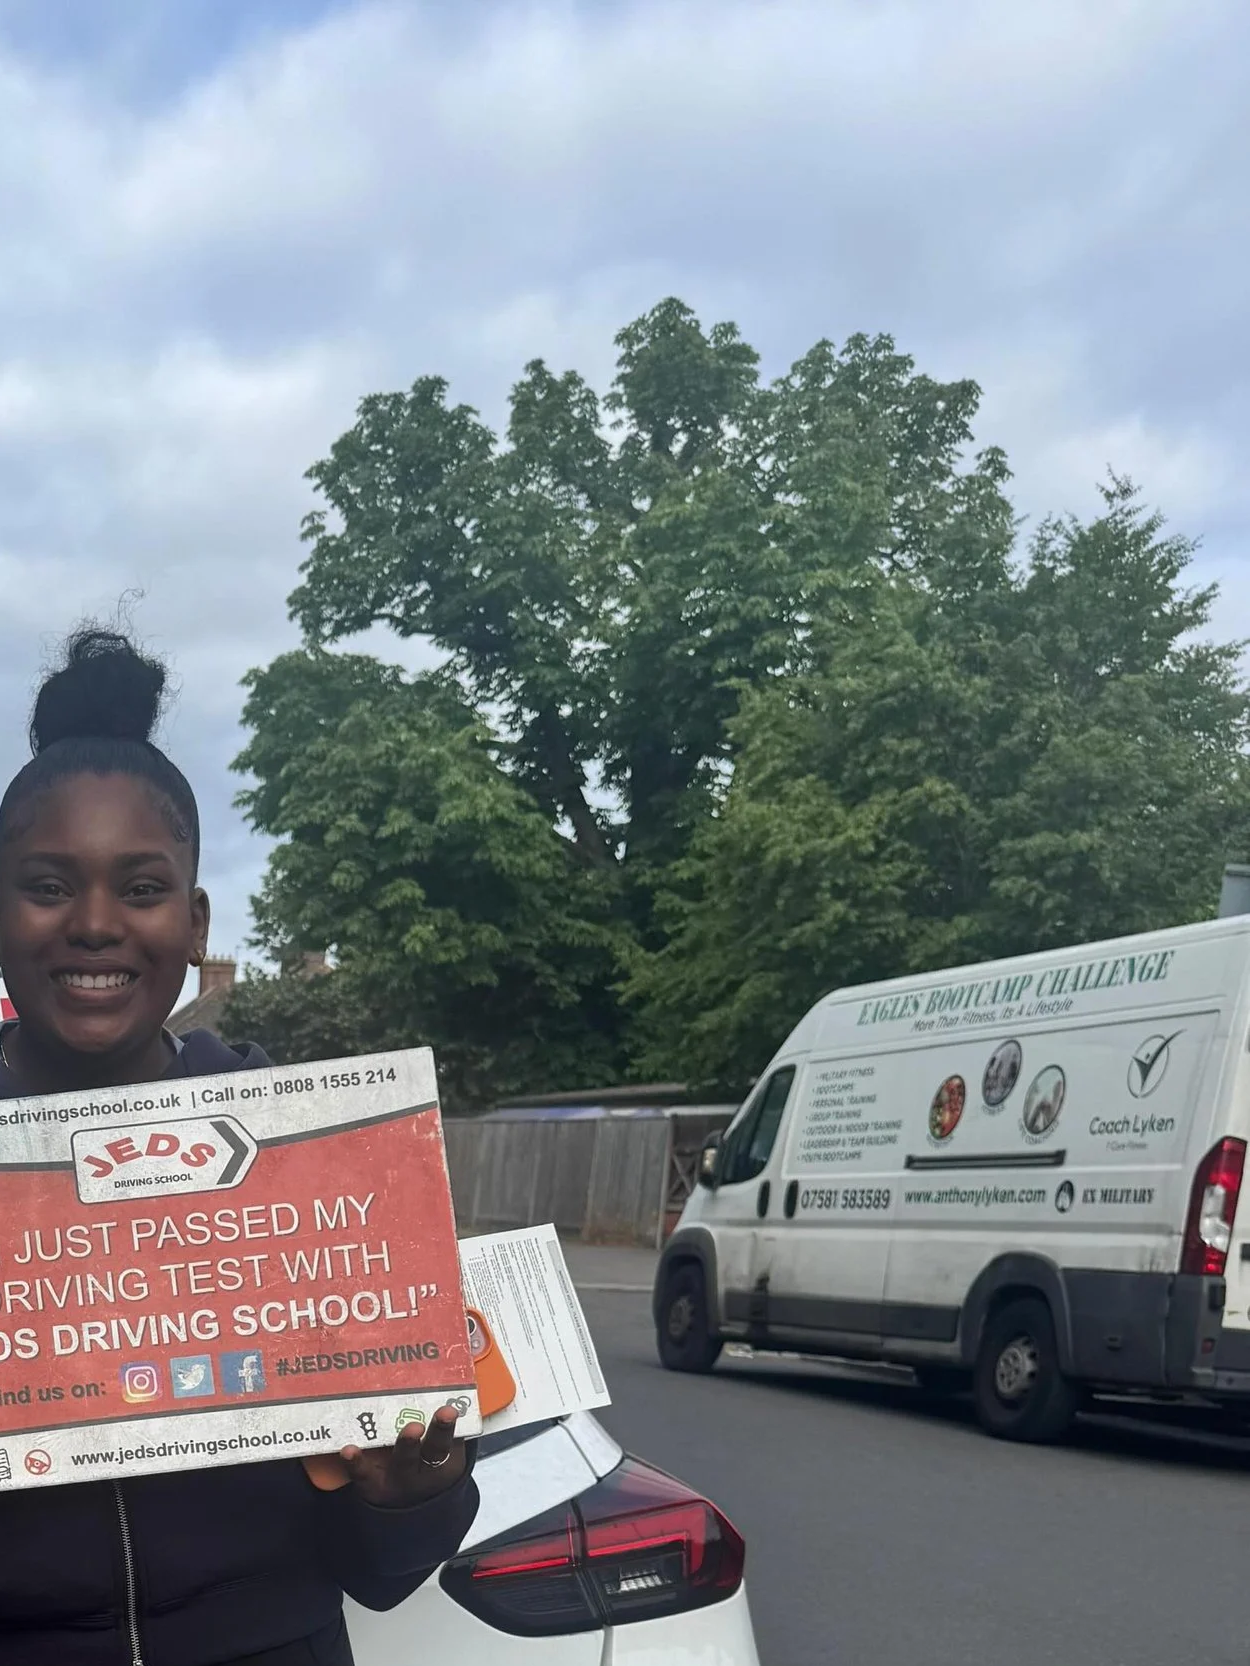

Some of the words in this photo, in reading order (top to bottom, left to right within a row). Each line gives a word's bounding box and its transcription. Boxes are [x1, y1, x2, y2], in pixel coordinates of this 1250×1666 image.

[924, 974, 1033, 1015] BOOTCAMP
[1036, 951, 1175, 998] CHALLENGE
[911, 1019, 934, 1032] More
[936, 1016, 958, 1028] Than
[1025, 997, 1073, 1017] Lifestyle
[201, 1086, 234, 1104] Call
[240, 1085, 268, 1100] on:
[274, 1078, 314, 1096] 0808
[320, 1072, 361, 1090] 1555
[366, 1067, 397, 1085] 214
[848, 1066, 875, 1077] FITNESS
[811, 1097, 844, 1108] PERSONAL
[847, 1093, 877, 1105] TRAINING
[806, 1124, 837, 1136] OUTDOOR
[1089, 1115, 1130, 1136] Coach
[1132, 1114, 1175, 1137] Lyken
[83, 1133, 216, 1178] JEDS
[114, 1177, 153, 1189] DRIVING
[154, 1173, 193, 1185] SCHOOL
[801, 1189, 837, 1209] 07581
[841, 1188, 891, 1209] 583589
[904, 1186, 1046, 1207] www.anthonylyken.com
[1082, 1188, 1097, 1204] EX
[1100, 1188, 1155, 1204] MILITARY
[14, 1221, 118, 1265] JUST
[131, 1202, 299, 1252] PASSED
[313, 1192, 375, 1231] MY
[159, 1254, 269, 1297] TEST
[280, 1240, 391, 1284] WITH
[52, 1309, 220, 1356] DRIVING
[232, 1283, 437, 1336] SCHOOL!”
[276, 1341, 440, 1377] #JEDSDRIVING
[38, 1386, 65, 1402] us
[71, 1381, 106, 1399] on:
[71, 1426, 332, 1466] www.jedsdrivingschool.co.uk
